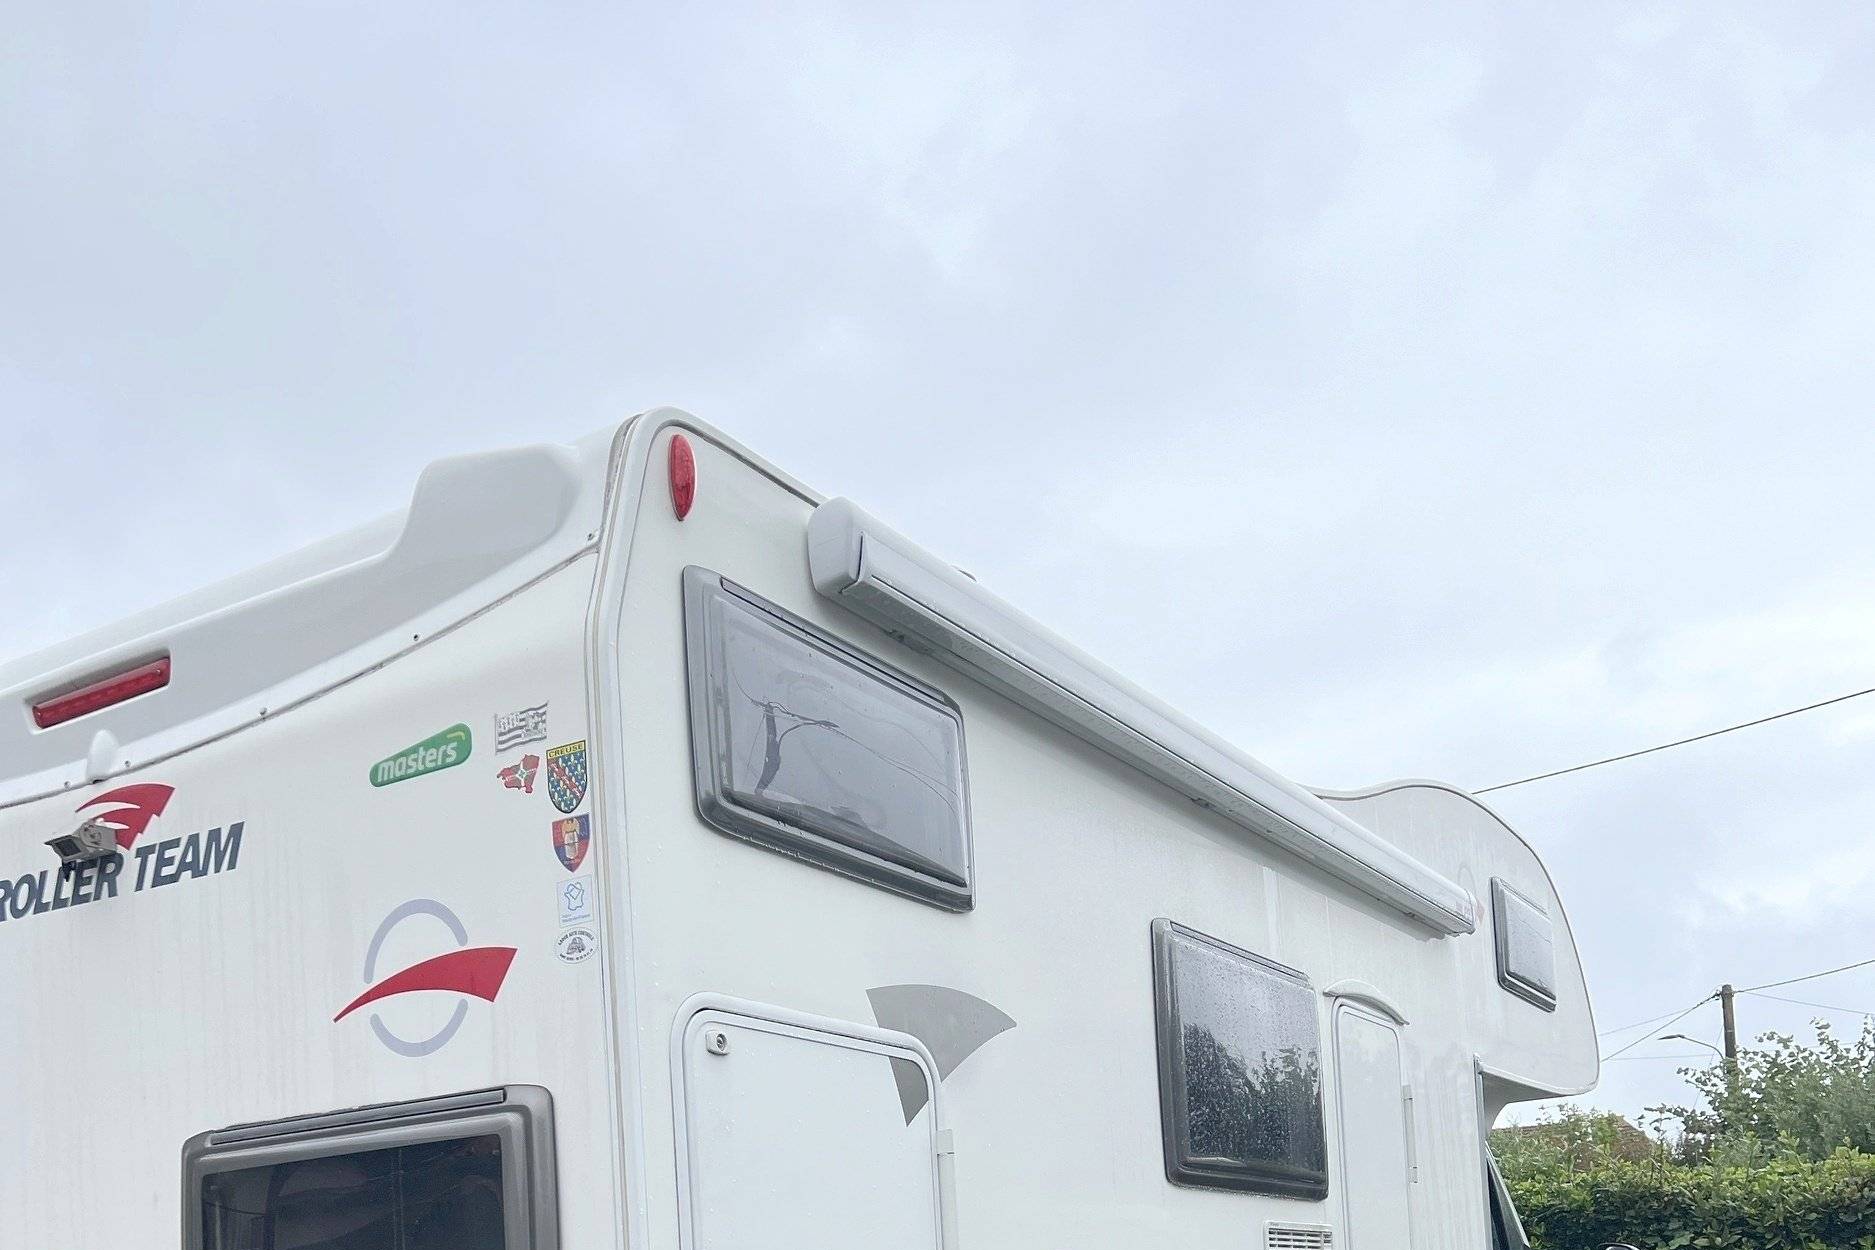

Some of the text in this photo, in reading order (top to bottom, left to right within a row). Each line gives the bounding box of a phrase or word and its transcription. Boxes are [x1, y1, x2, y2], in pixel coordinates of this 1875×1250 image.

[377, 741, 458, 782] masters
[549, 742, 584, 758] CREUSE
[134, 821, 245, 892] TEAM
